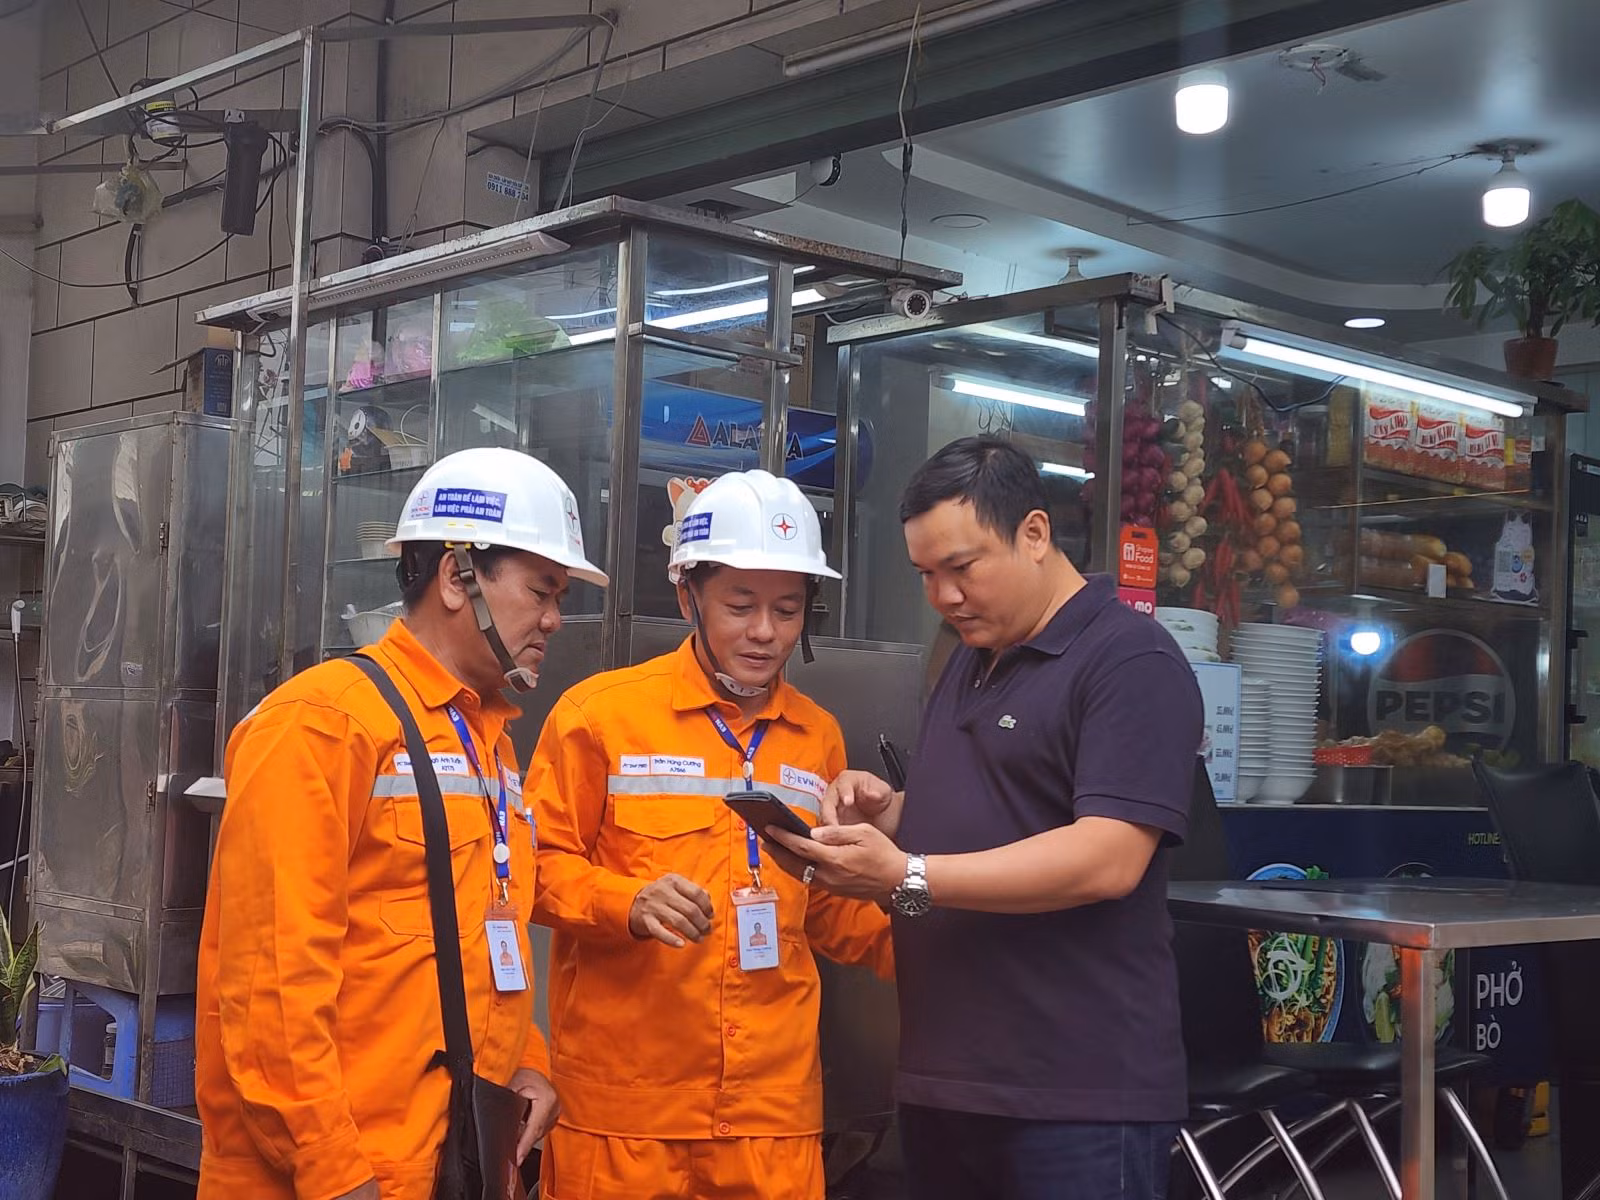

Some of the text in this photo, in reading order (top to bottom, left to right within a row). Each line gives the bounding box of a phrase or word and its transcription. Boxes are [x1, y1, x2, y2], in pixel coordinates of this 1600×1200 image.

[711, 419, 804, 460] ALAA
[1376, 690, 1506, 724] PEPSI
[1476, 960, 1523, 1009] PHỞ
[1476, 1014, 1501, 1051] BÒ
